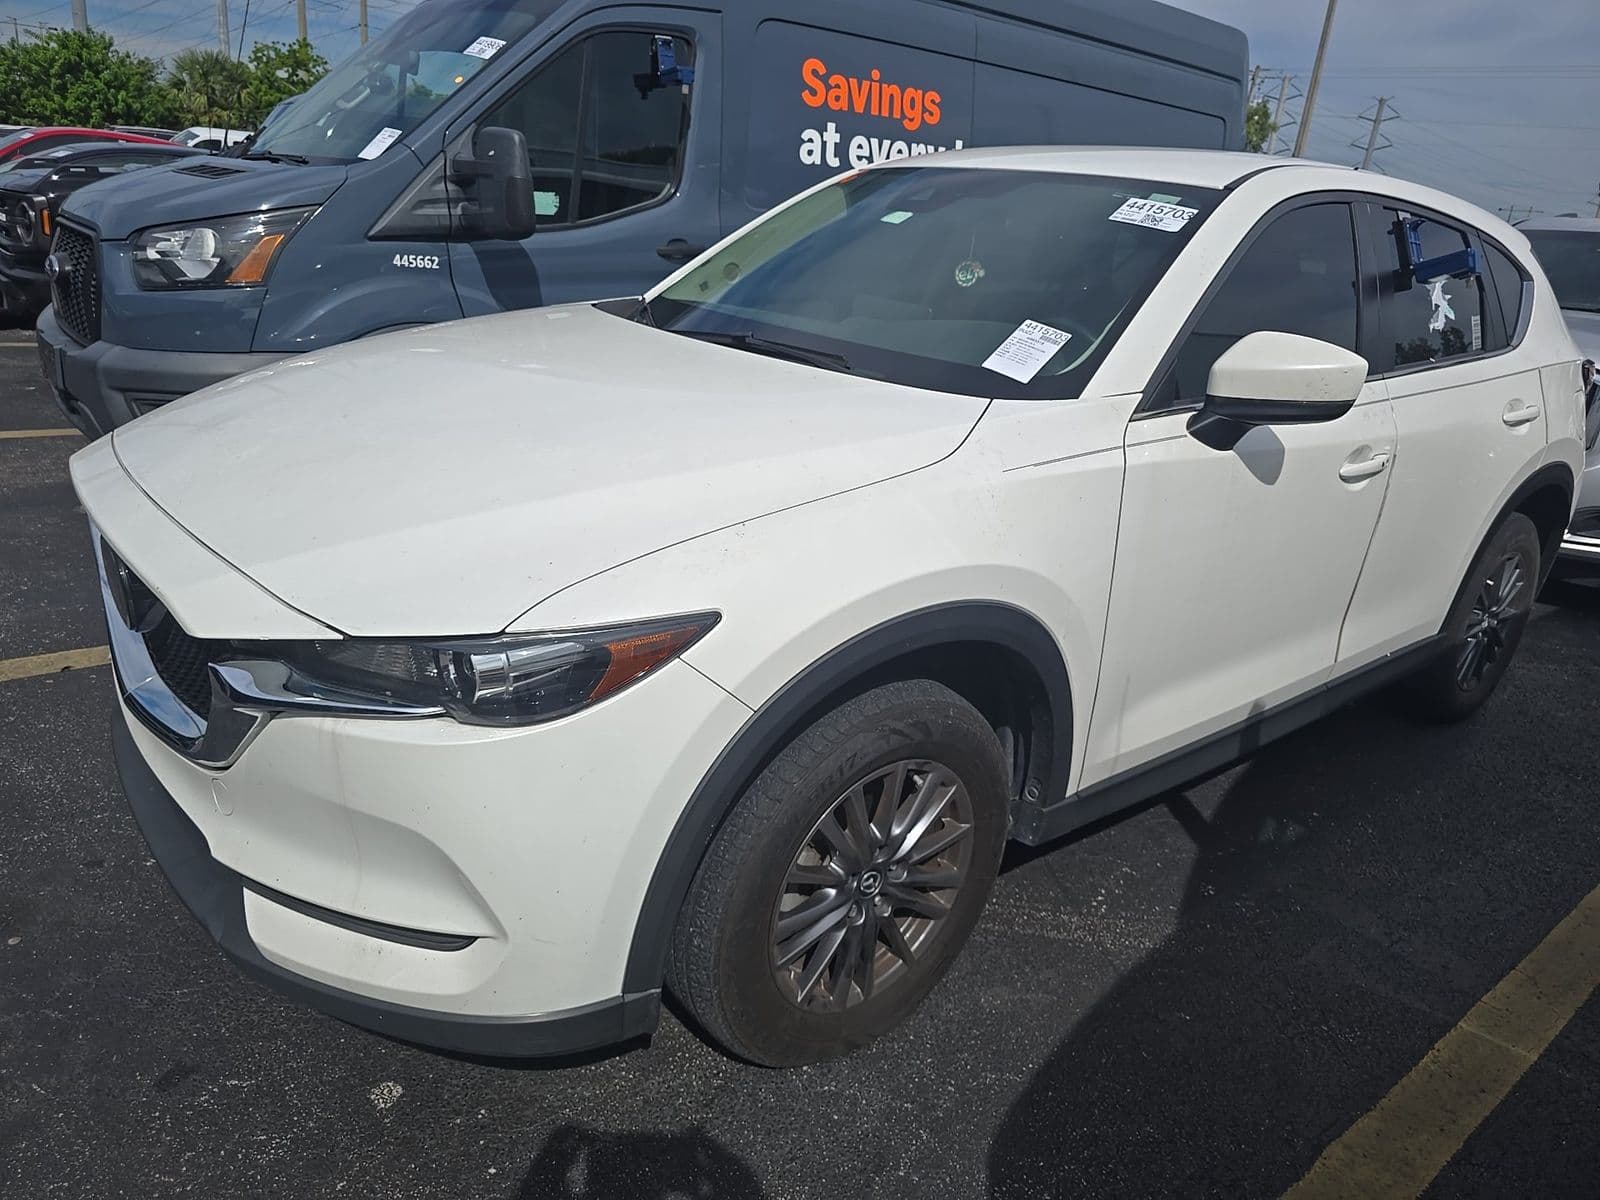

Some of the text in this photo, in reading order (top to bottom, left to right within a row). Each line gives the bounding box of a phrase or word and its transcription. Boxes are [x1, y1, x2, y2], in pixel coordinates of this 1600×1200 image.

[802, 58, 941, 131] Savings
[800, 122, 946, 169] at eve
[1126, 201, 1195, 220] 4415703
[393, 254, 440, 269] 445662
[1024, 322, 1070, 342] 4415703
